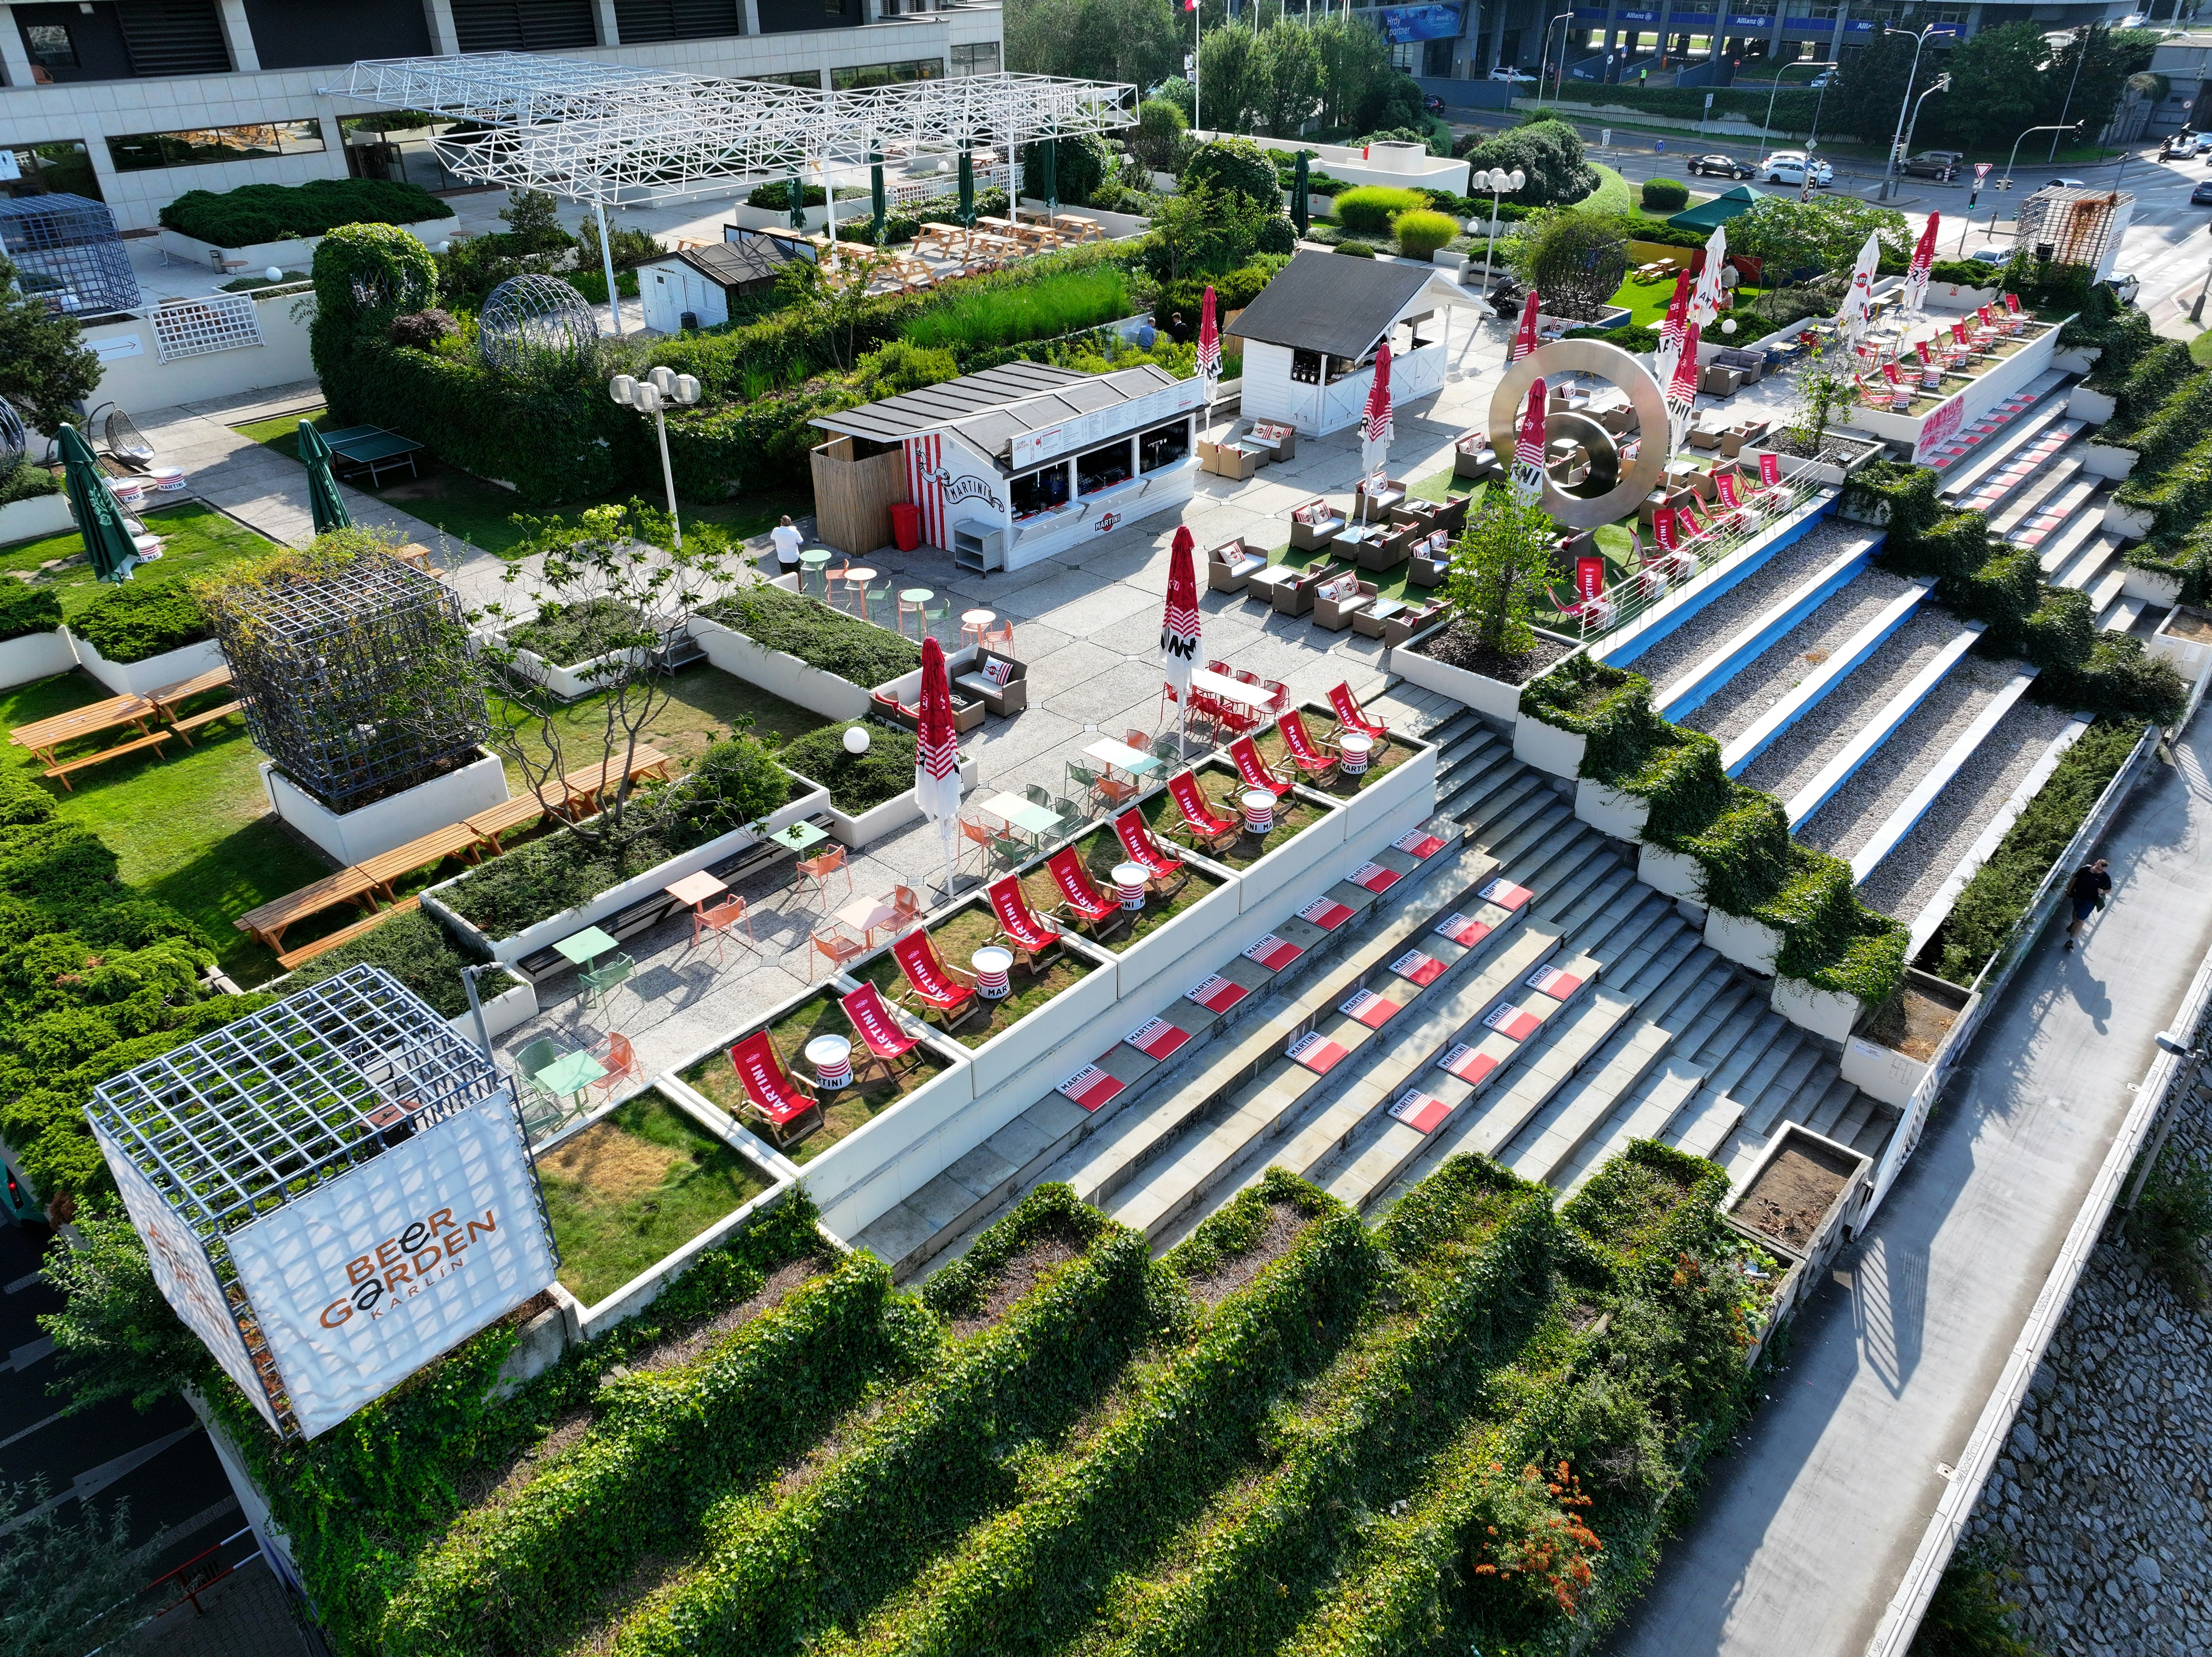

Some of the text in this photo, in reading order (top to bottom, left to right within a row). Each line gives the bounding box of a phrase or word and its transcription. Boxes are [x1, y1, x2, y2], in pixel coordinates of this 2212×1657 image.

[1387, 15, 1401, 27] Hrdý
[1389, 27, 1410, 38] partner
[950, 480, 986, 500] MARTINI
[1095, 514, 1120, 531] MARTINI
[1342, 583, 1356, 591] MARTINI
[985, 665, 1001, 675] MARTINI
[1395, 829, 1418, 846] MARTINI
[1349, 862, 1374, 880] MARTINI
[1482, 879, 1504, 896] MARTINI
[1300, 897, 1326, 916] MARTINI
[1005, 902, 1040, 945] MARTINI
[1442, 913, 1463, 932] MARTINI
[908, 950, 919, 959] MARTINI
[1246, 934, 1274, 956] MARTINI
[1395, 950, 1419, 970] MARTINI
[912, 959, 954, 1002] MARTINI
[1530, 966, 1551, 985] MARTINI
[1189, 975, 1219, 997] MARTINI
[855, 999, 868, 1009] MARTINI
[1344, 990, 1370, 1012] MARTINI
[1487, 1004, 1509, 1024] MARTINI
[861, 1008, 903, 1053] MARTINI
[1129, 1018, 1160, 1042] MARTINI
[1289, 1033, 1318, 1056] MARTINI
[746, 1052, 760, 1063] MARTINI
[1442, 1044, 1467, 1066] MARTINI
[750, 1063, 793, 1114] MARTINI
[1061, 1066, 1094, 1091] MARTINI
[1393, 1090, 1418, 1115] MARTINI
[370, 1258, 464, 1321] KARLÍN
